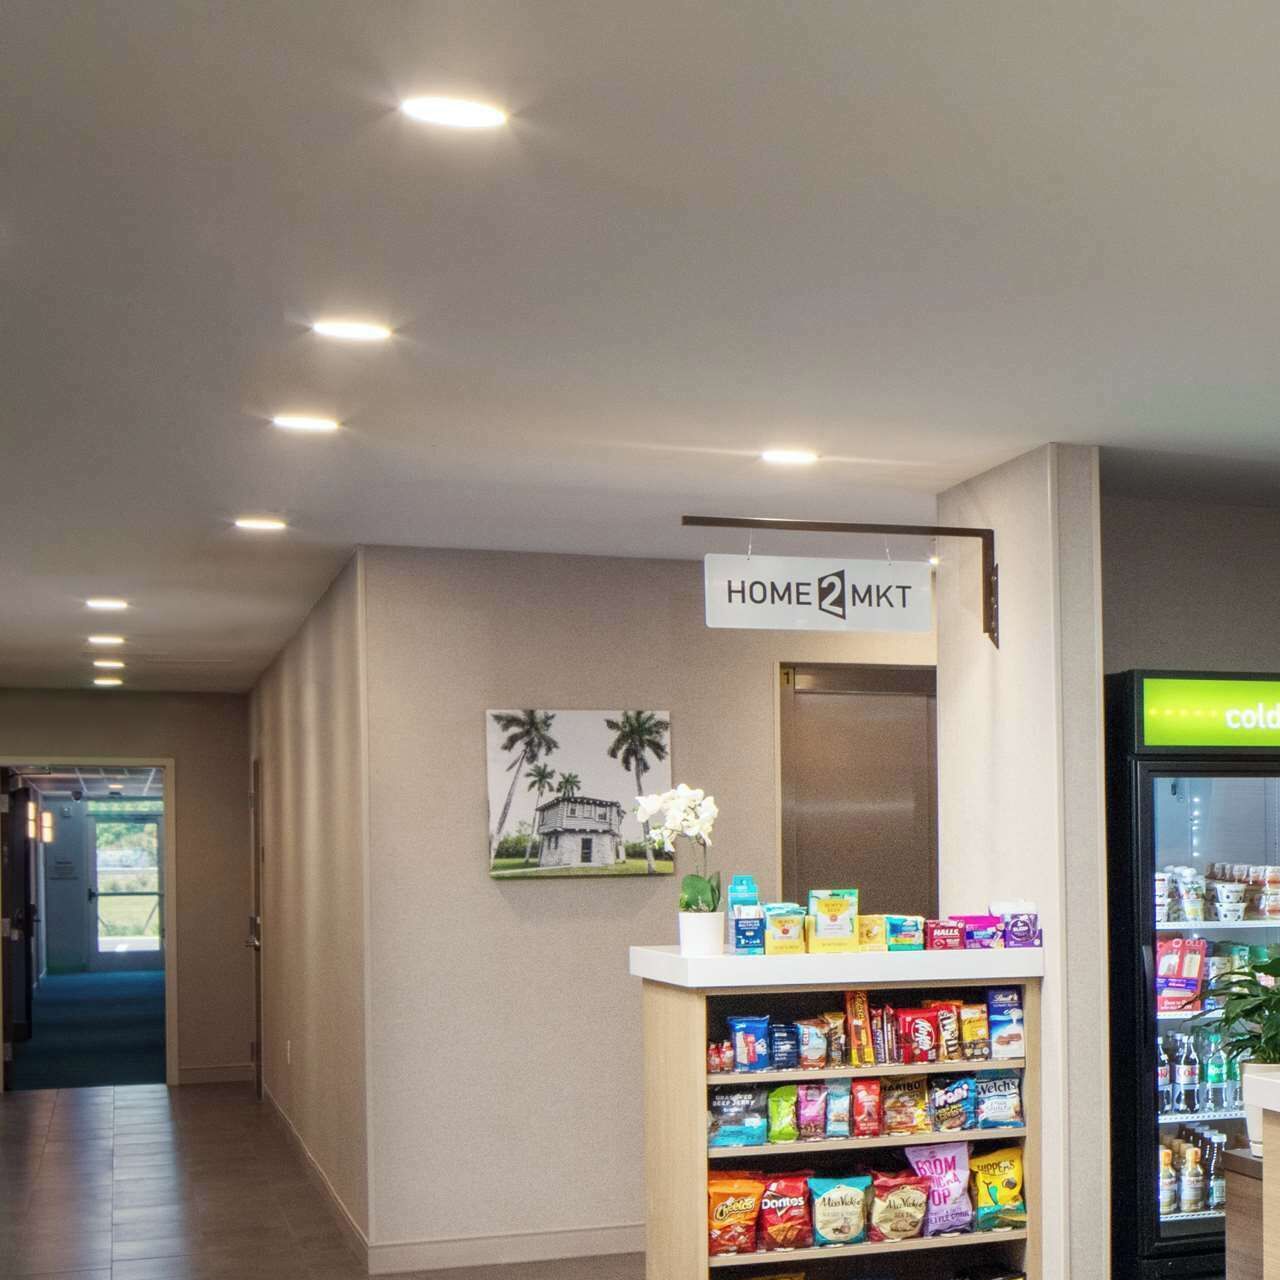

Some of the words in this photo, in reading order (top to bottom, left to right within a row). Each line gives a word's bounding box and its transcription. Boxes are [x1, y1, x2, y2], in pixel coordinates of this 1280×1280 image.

[933, 928, 960, 938] HALLS
[977, 1078, 1017, 1096] Welch's
[915, 1155, 957, 1176] BOOM
[761, 1196, 805, 1210] Doritos
[931, 1188, 951, 1207] OP
